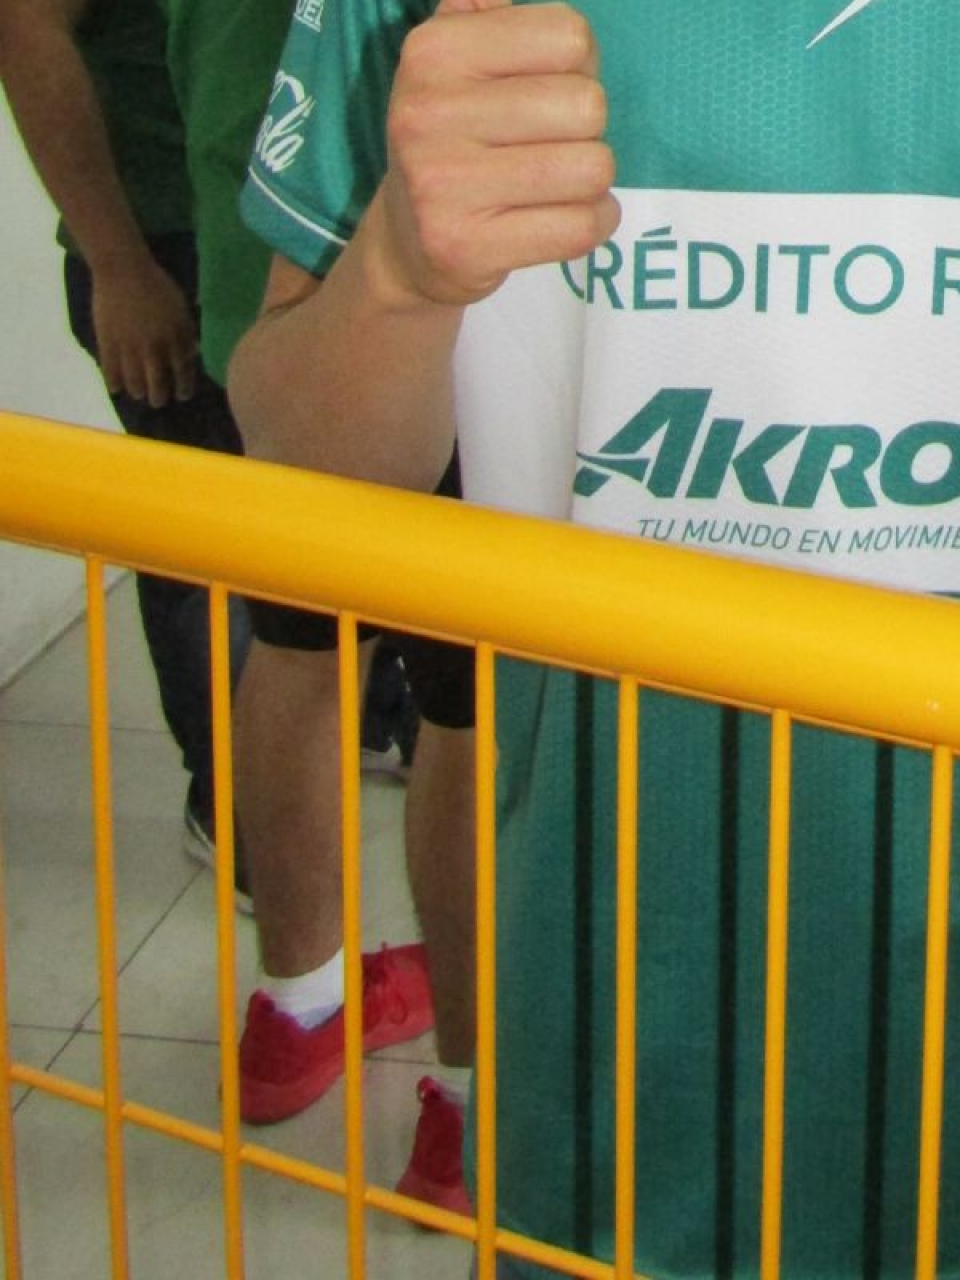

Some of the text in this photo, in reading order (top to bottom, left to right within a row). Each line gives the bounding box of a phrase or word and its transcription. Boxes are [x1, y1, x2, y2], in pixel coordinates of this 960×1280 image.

[638, 519, 673, 541] TU
[684, 520, 790, 551] MUNDO
[799, 530, 841, 554] EN
